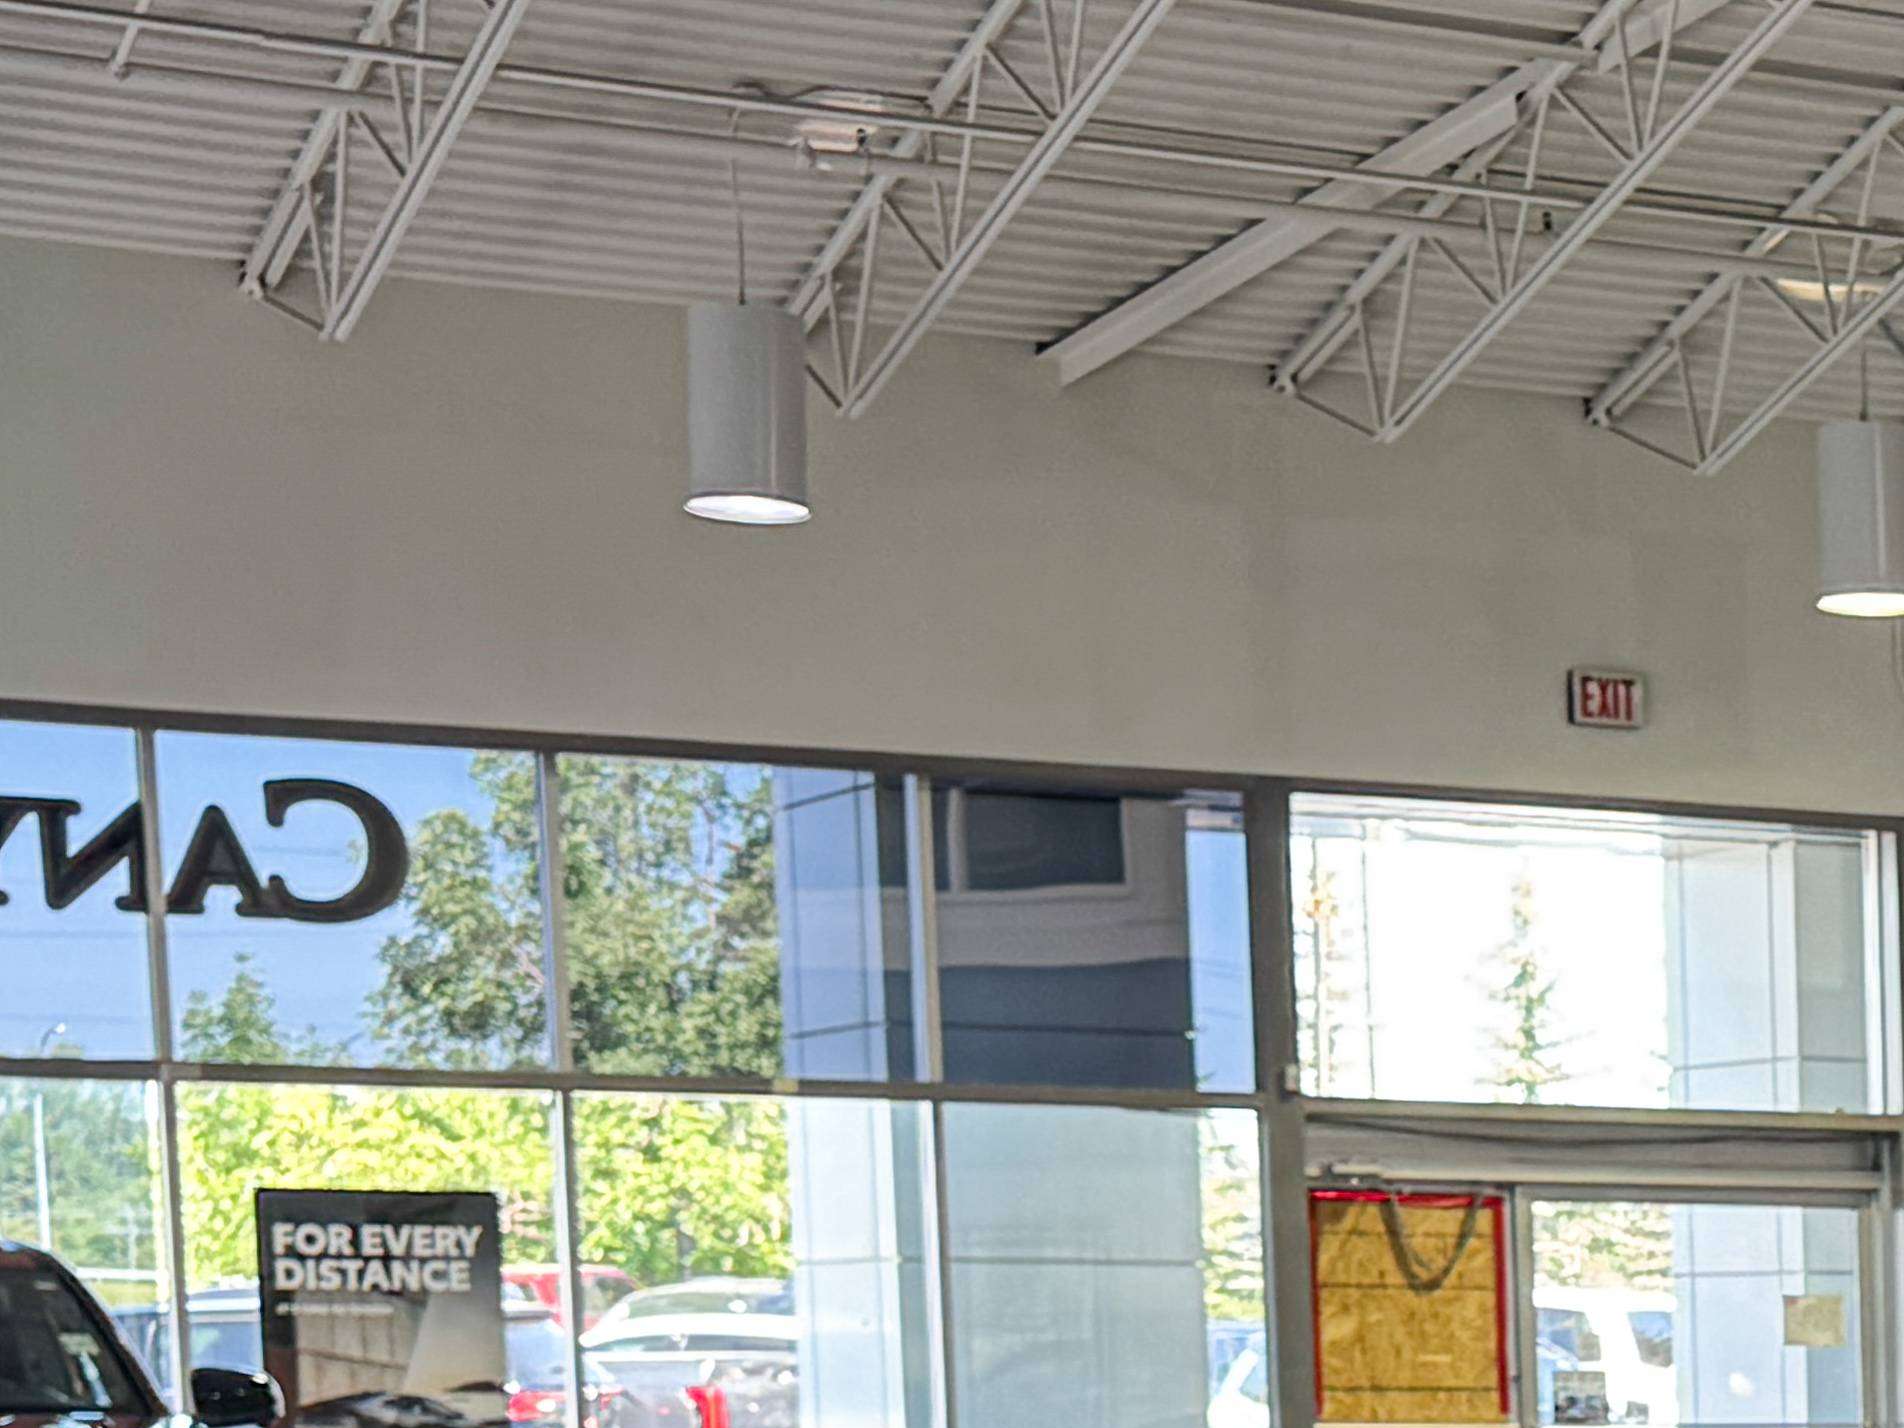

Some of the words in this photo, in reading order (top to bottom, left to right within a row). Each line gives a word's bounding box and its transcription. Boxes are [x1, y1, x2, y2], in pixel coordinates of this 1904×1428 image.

[1582, 676, 1635, 722] EXIT
[272, 1222, 354, 1256] FOR
[360, 1223, 483, 1257] EVERY
[273, 1258, 472, 1292] DISTANCE
